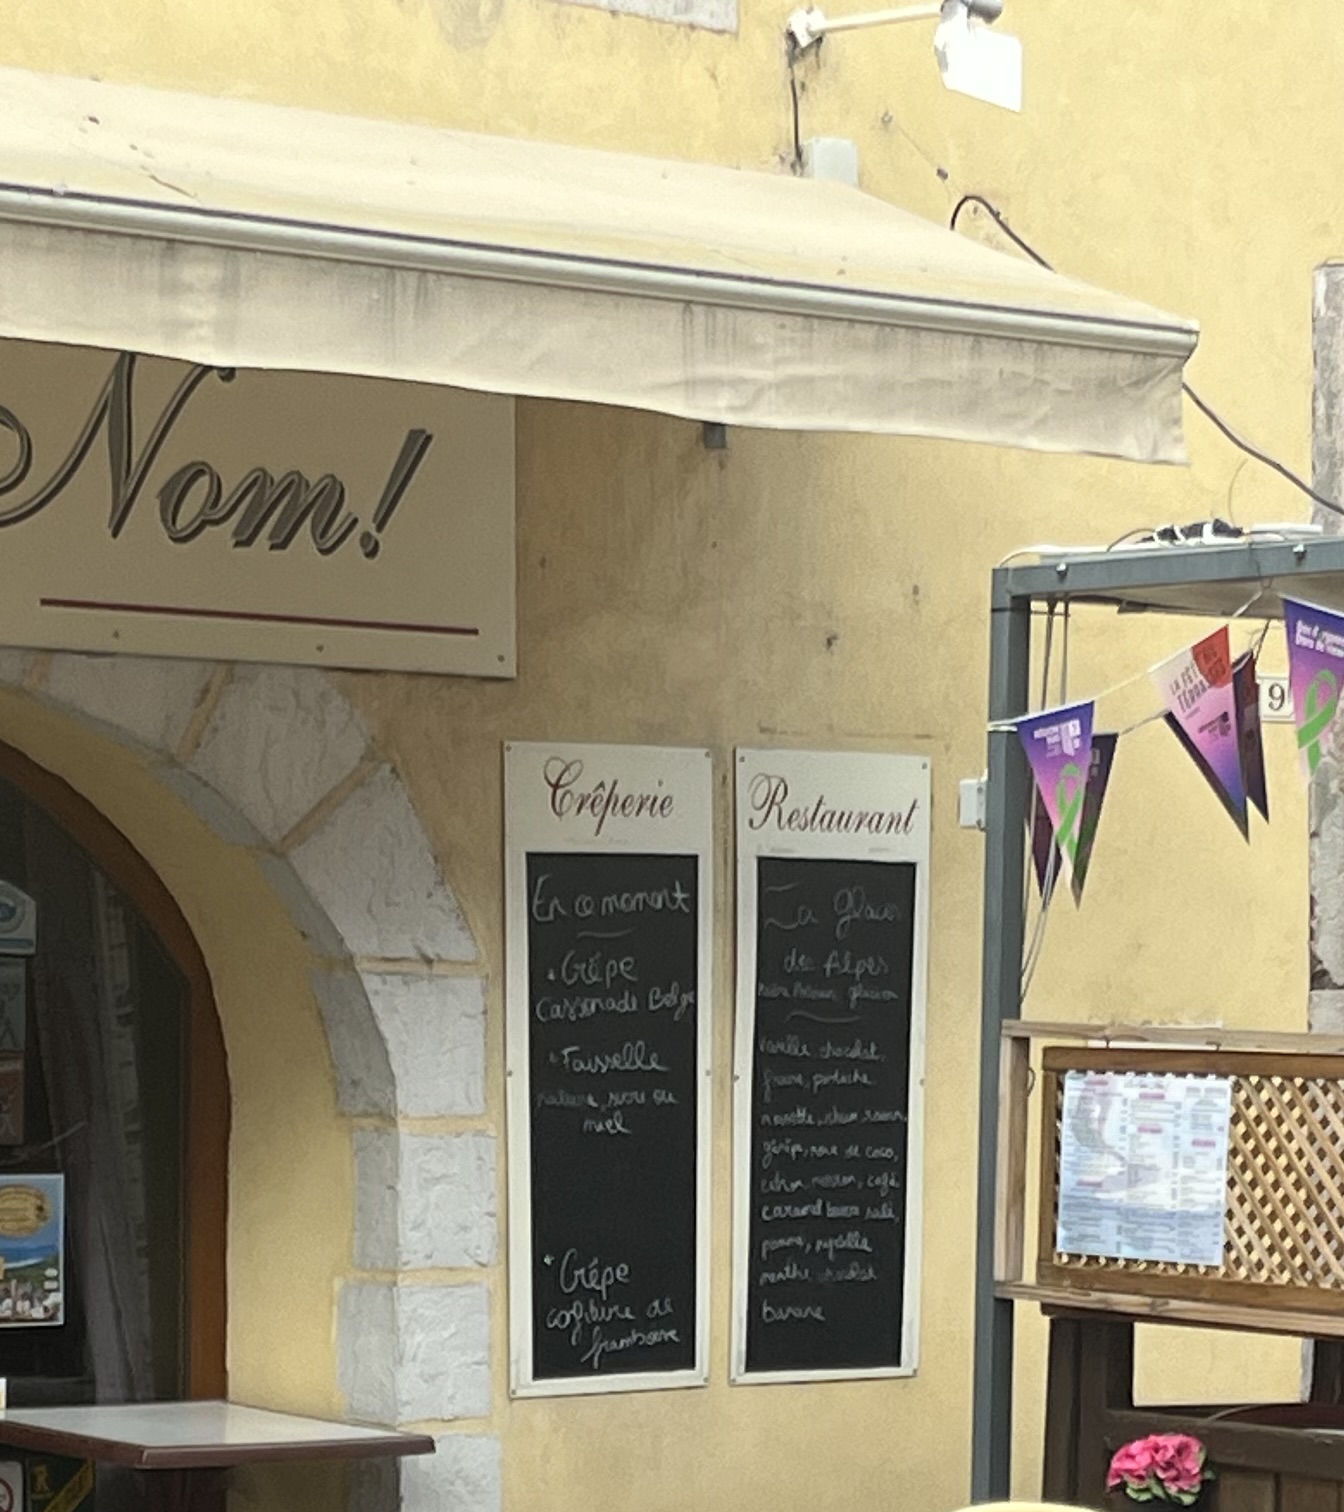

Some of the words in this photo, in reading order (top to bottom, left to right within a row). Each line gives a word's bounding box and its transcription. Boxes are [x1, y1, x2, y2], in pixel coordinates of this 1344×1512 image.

[1268, 683, 1285, 711] 9
[543, 756, 674, 836] Crêperie
[748, 772, 919, 836] Restaurant
